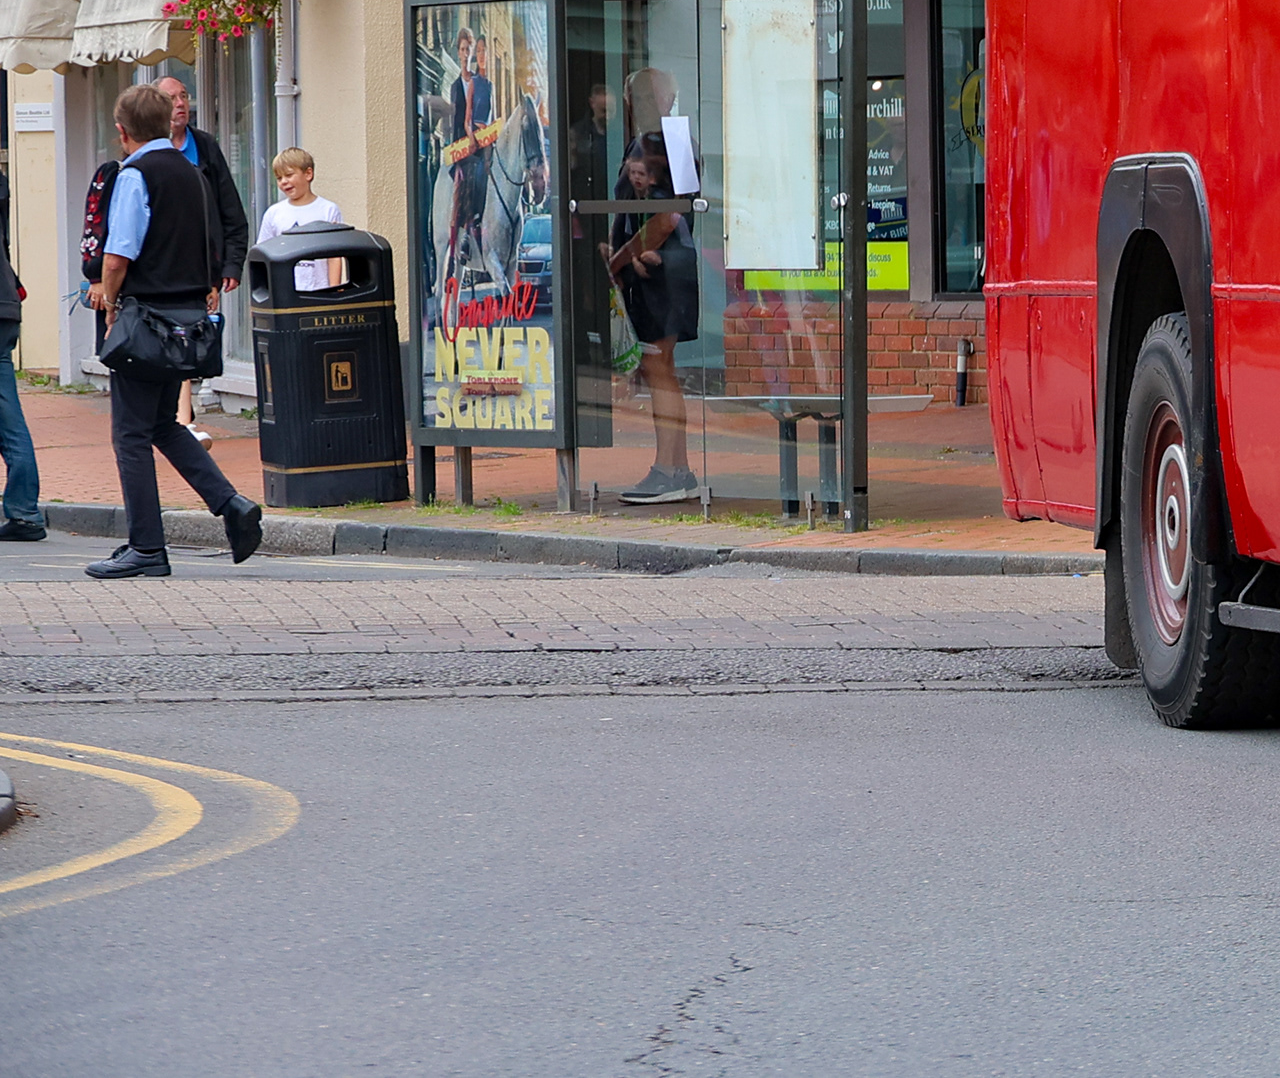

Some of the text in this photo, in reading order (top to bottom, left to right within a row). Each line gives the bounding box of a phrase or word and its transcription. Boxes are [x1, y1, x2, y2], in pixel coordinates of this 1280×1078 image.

[868, 149, 889, 159] Advice
[879, 165, 894, 175] VAT
[867, 183, 891, 192] Returns
[868, 253, 891, 262] discuss
[442, 270, 539, 343] Commute
[314, 314, 365, 326] LITTER
[434, 327, 552, 384] NEVER
[435, 387, 553, 429] SQUARE
